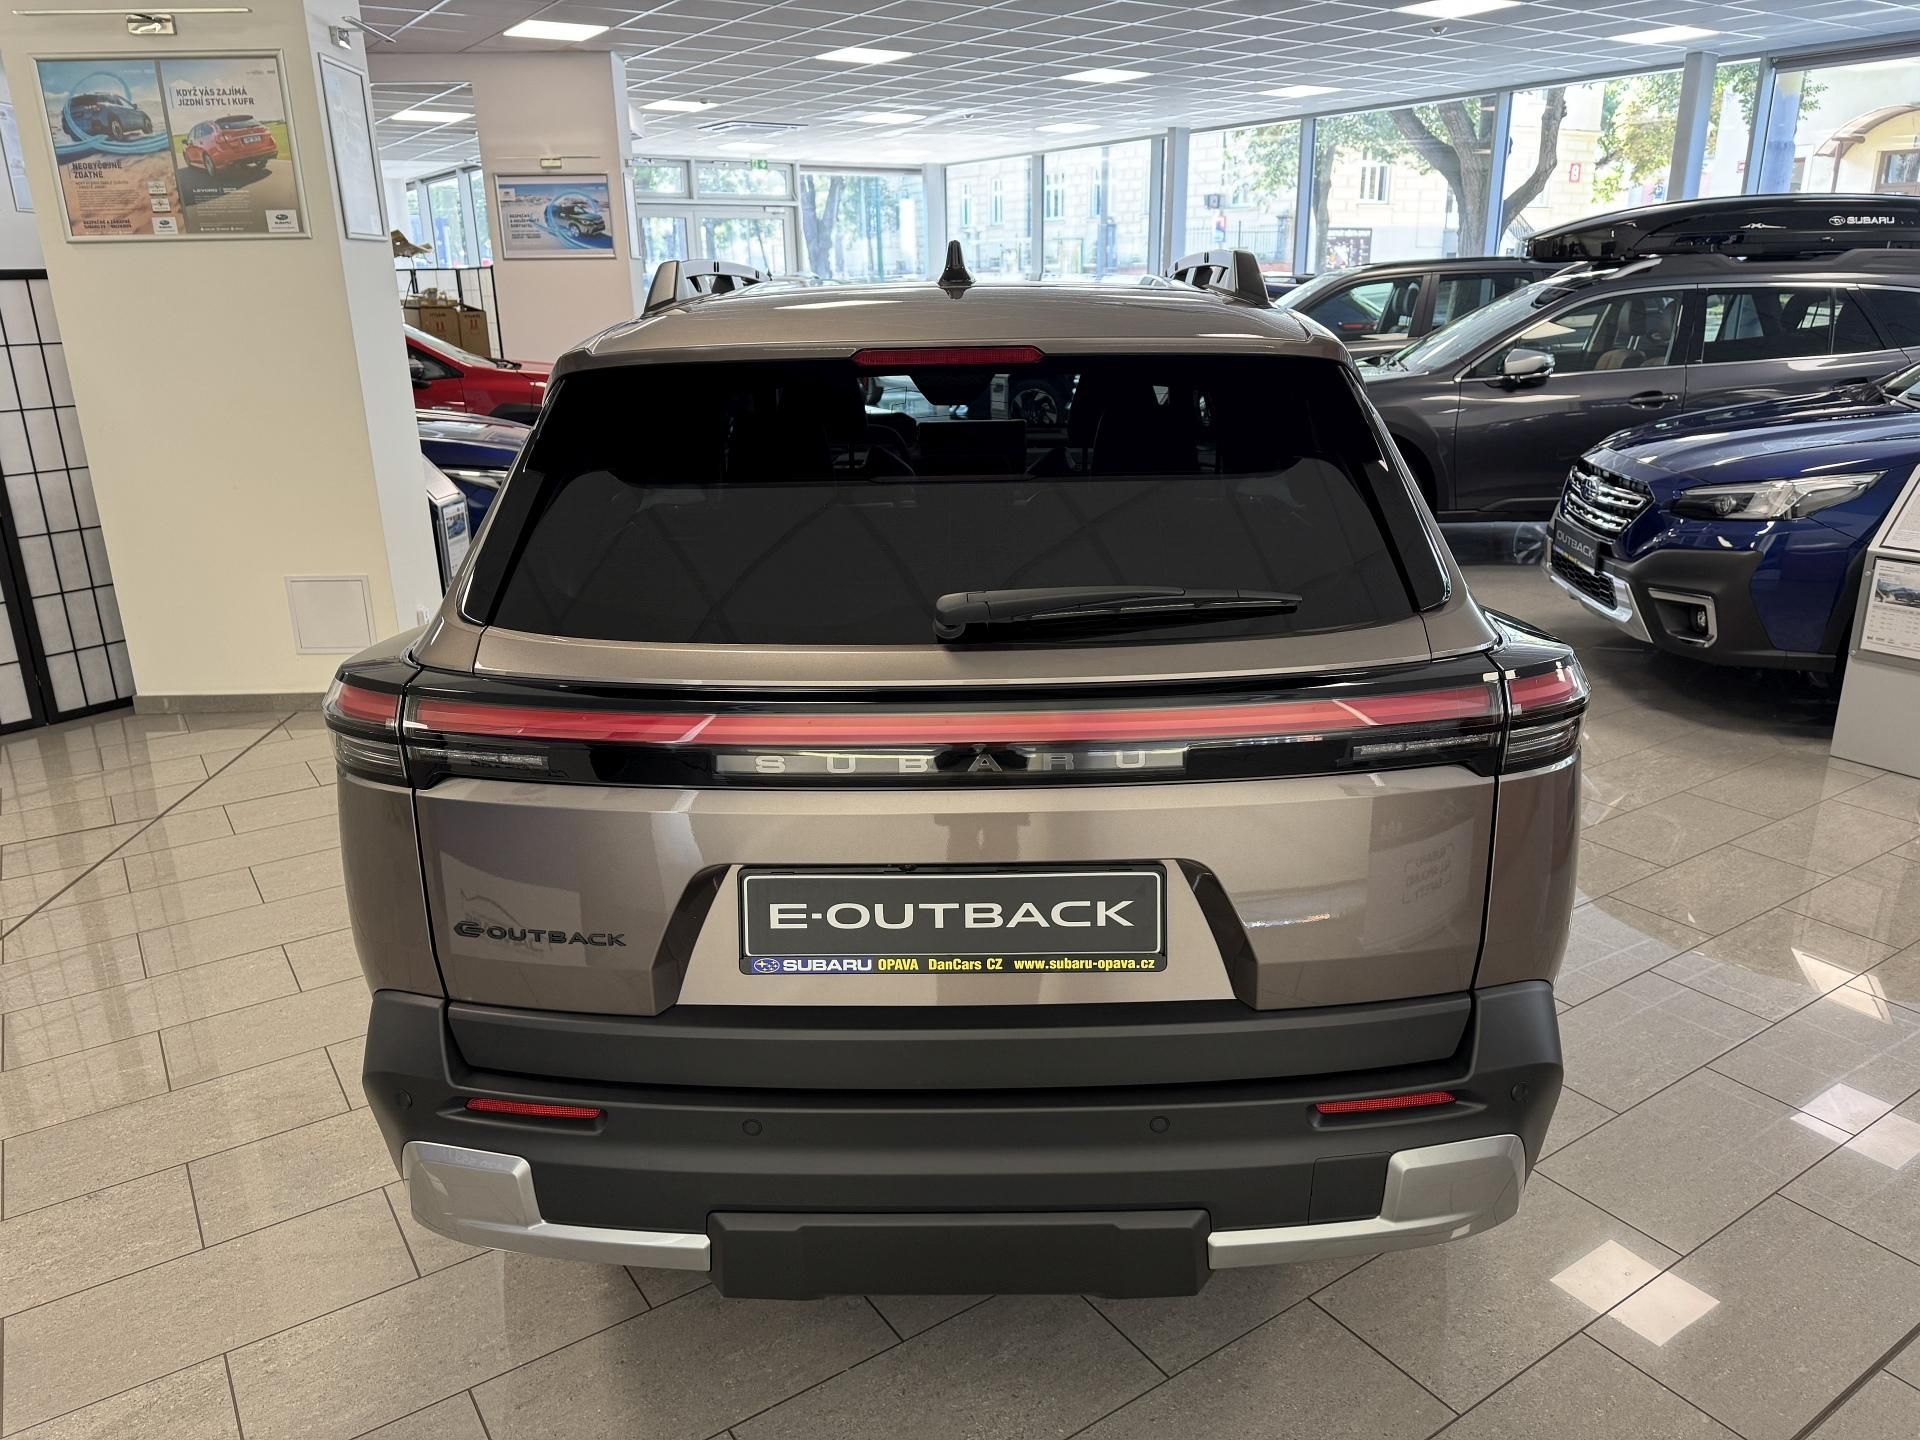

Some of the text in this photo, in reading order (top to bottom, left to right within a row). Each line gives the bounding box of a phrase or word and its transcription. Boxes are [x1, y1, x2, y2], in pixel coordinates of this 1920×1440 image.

[176, 85, 248, 97] KDYŽ VÁS ZAJÍMÁ
[178, 96, 204, 106] JÍZDNÍ
[206, 97, 226, 106] STYL
[232, 97, 255, 105] KUFR
[1847, 216, 1895, 225] SUBARU
[1556, 530, 1594, 559] OUTBACK
[755, 751, 1146, 774] SUBARU
[769, 900, 1135, 930] E-OUTBACK
[783, 958, 1155, 972] SUBARU OPAVA DanCars CZ www.subaru-opava.cz
